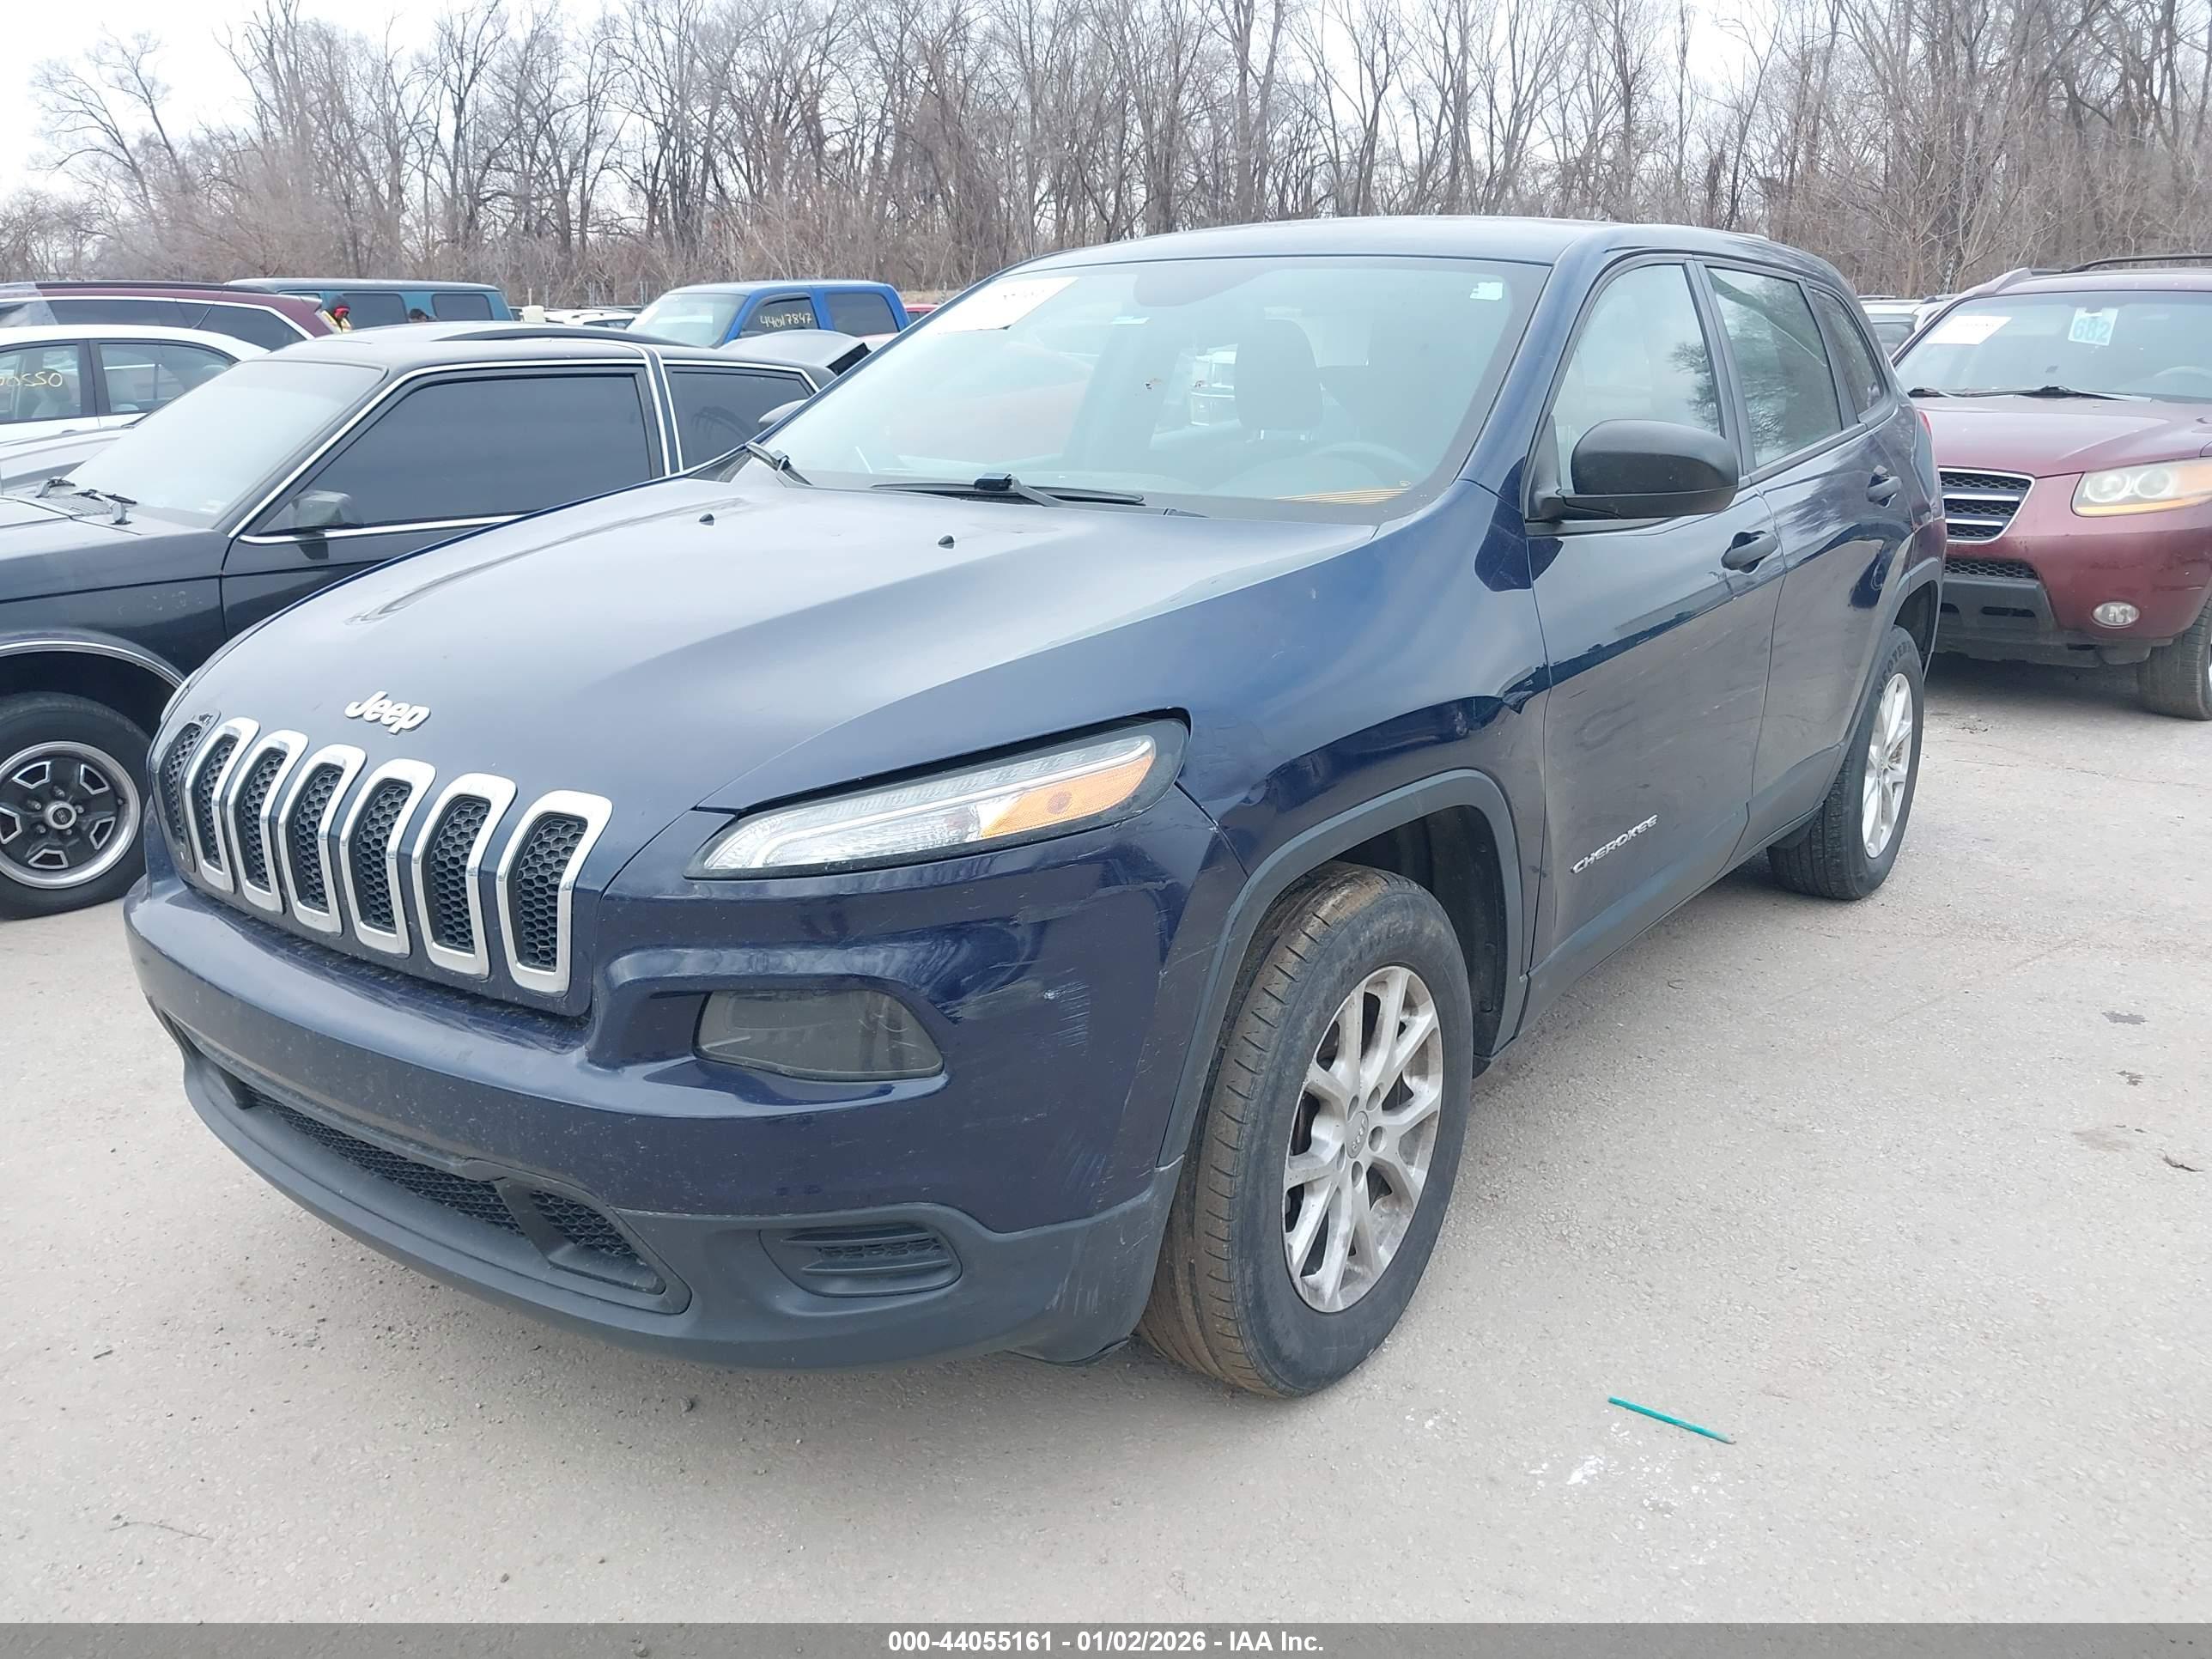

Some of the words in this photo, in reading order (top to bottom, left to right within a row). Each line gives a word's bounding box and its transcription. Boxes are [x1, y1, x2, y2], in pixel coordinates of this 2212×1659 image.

[759, 312, 813, 328] 44017847
[344, 690, 431, 735] Jeep
[1571, 814, 1659, 874] CHEROKEE
